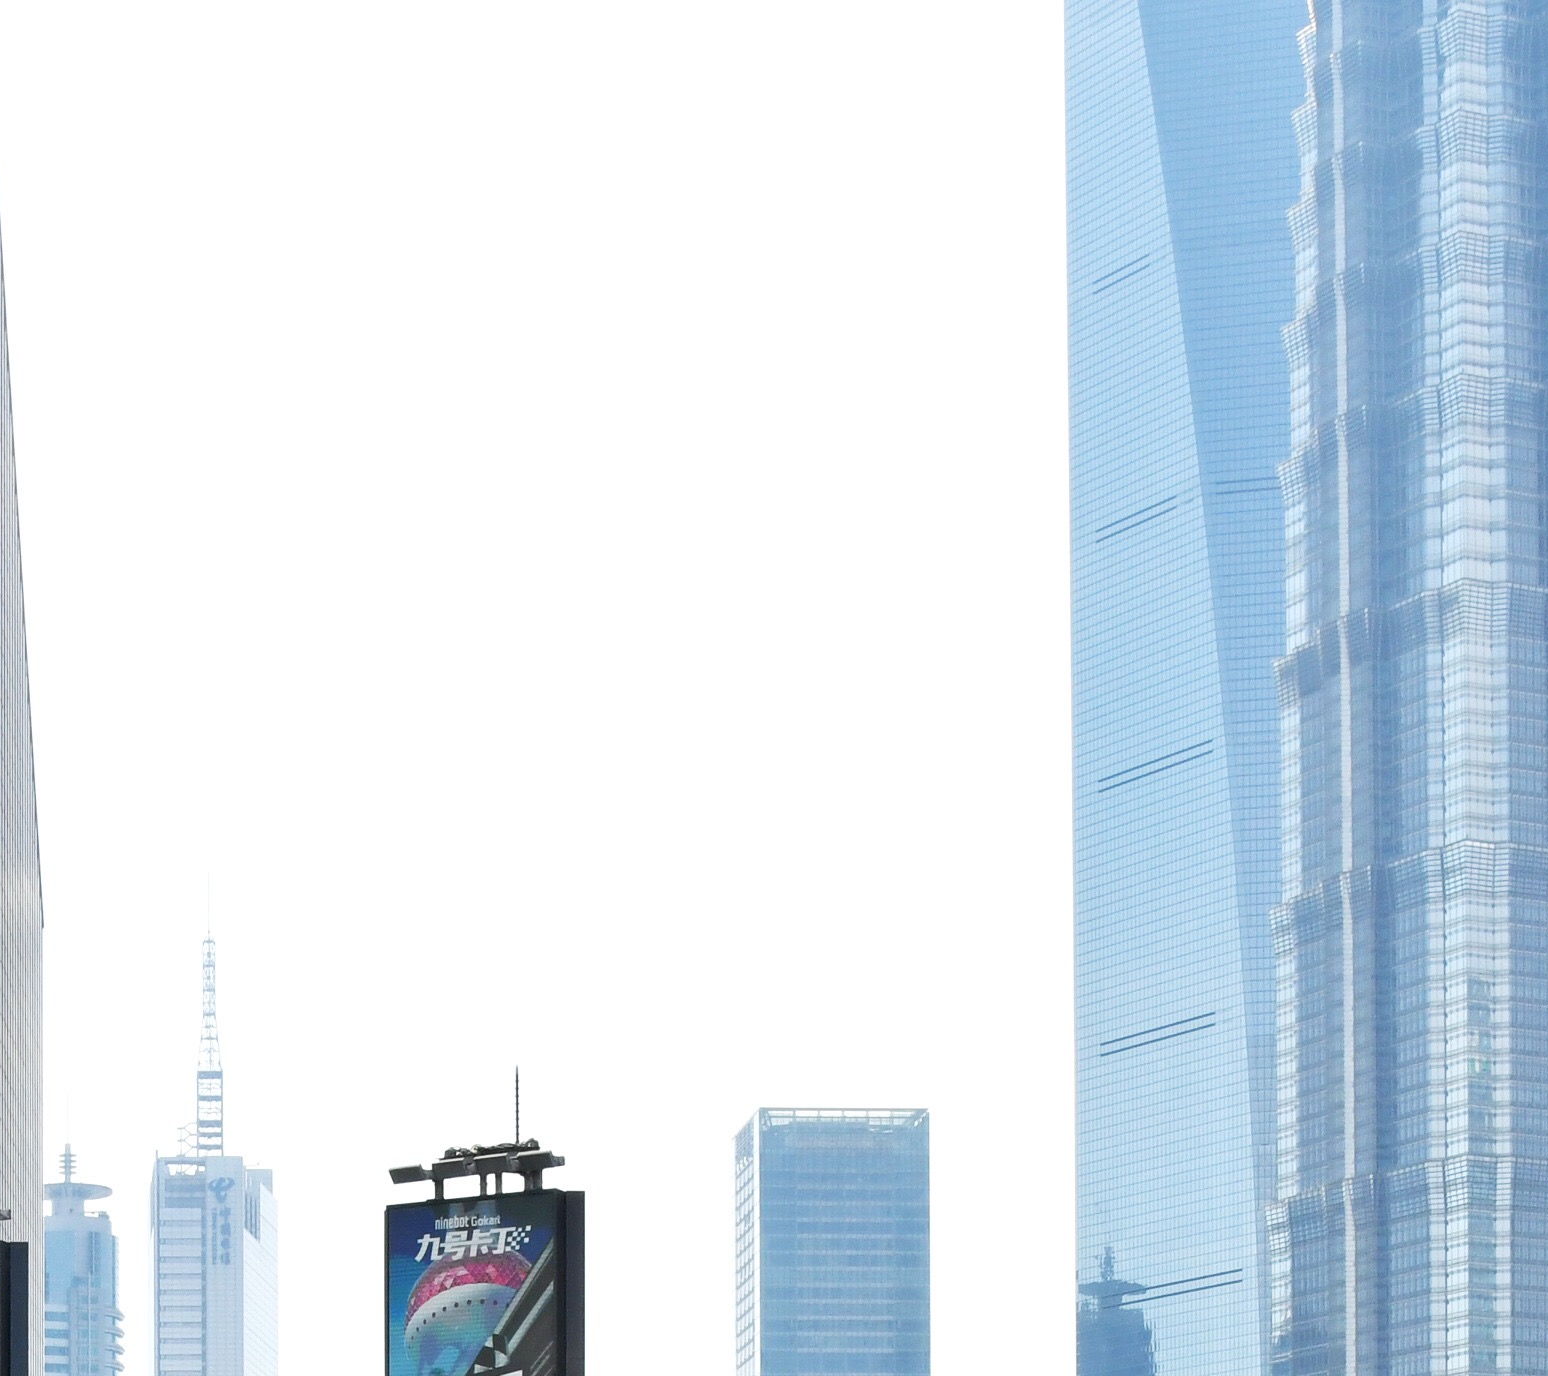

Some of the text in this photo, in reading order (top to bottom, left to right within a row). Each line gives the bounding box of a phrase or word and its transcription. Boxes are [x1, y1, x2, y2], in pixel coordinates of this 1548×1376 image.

[434, 1215, 501, 1229] ninebot Gokart
[416, 1228, 515, 1261] 九号卡丁
